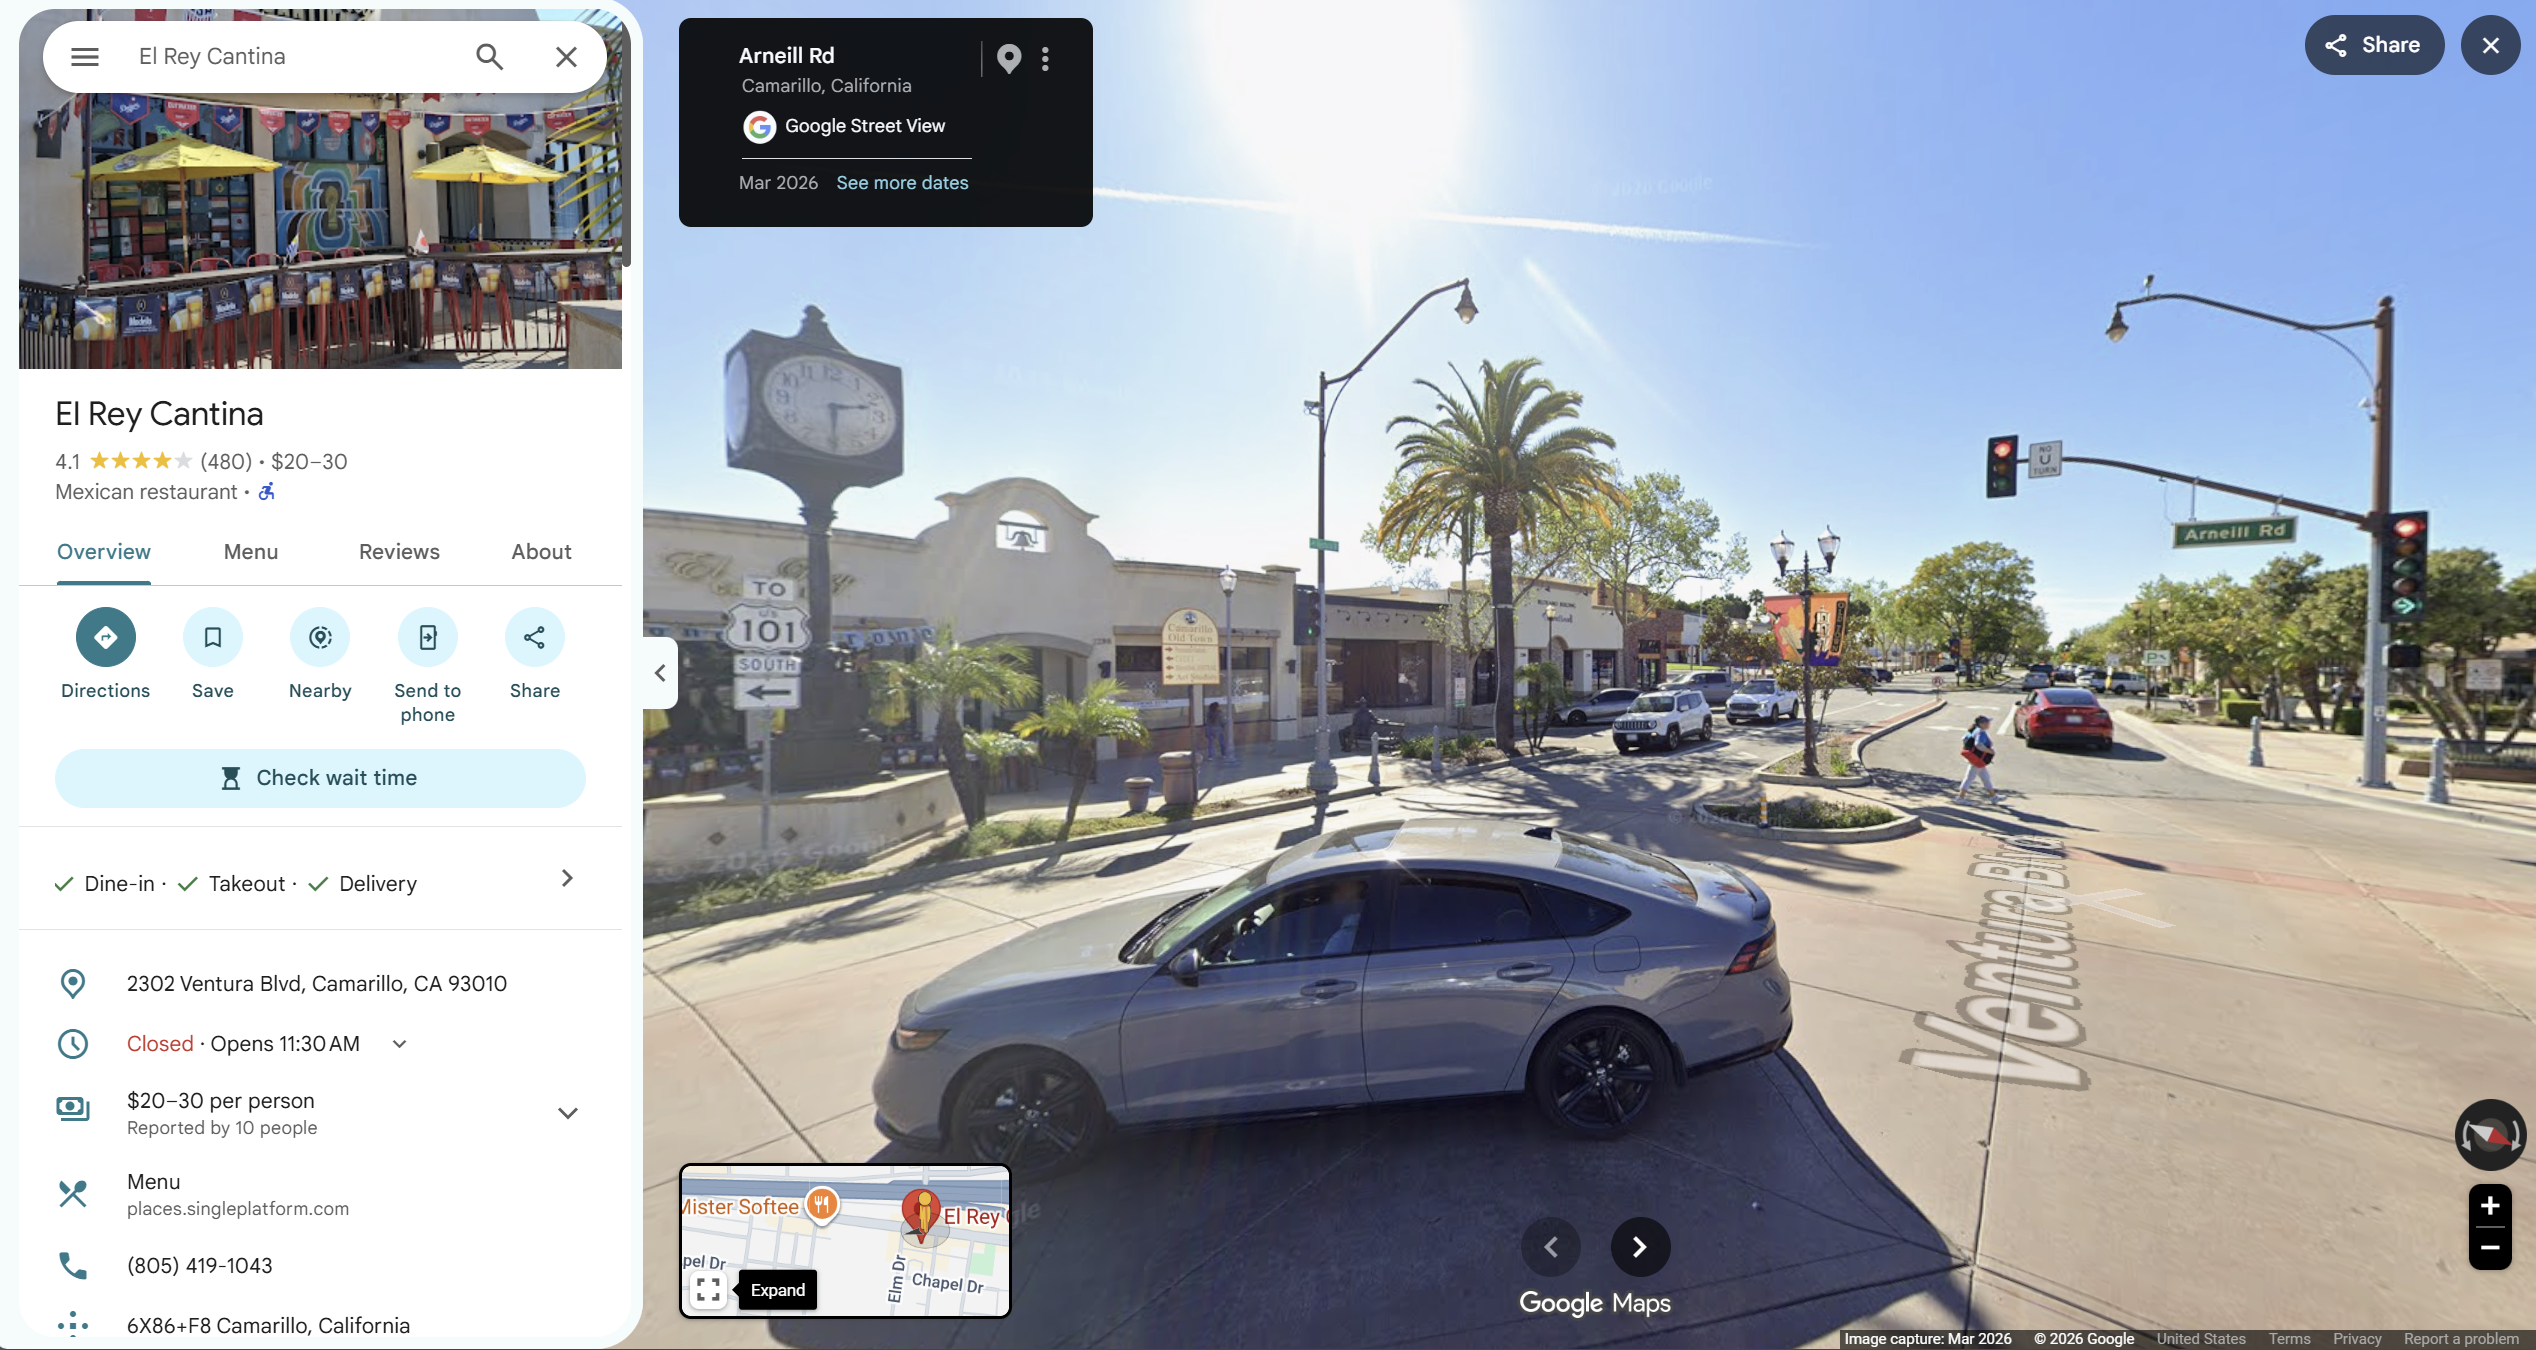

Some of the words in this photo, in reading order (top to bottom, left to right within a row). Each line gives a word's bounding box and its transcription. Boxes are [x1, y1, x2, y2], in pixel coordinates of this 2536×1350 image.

[2040, 455, 2051, 465] U
[2034, 466, 2057, 475] TURN
[2184, 526, 2250, 541] Arneill
[2259, 523, 2286, 537] Rd
[754, 582, 785, 597] TO
[743, 620, 794, 643] 101
[1168, 624, 1213, 633] Camarillo
[1168, 633, 1185, 643] Old
[1186, 635, 1213, 644] Town
[2147, 653, 2157, 664] P
[739, 659, 796, 671] SOUTH
